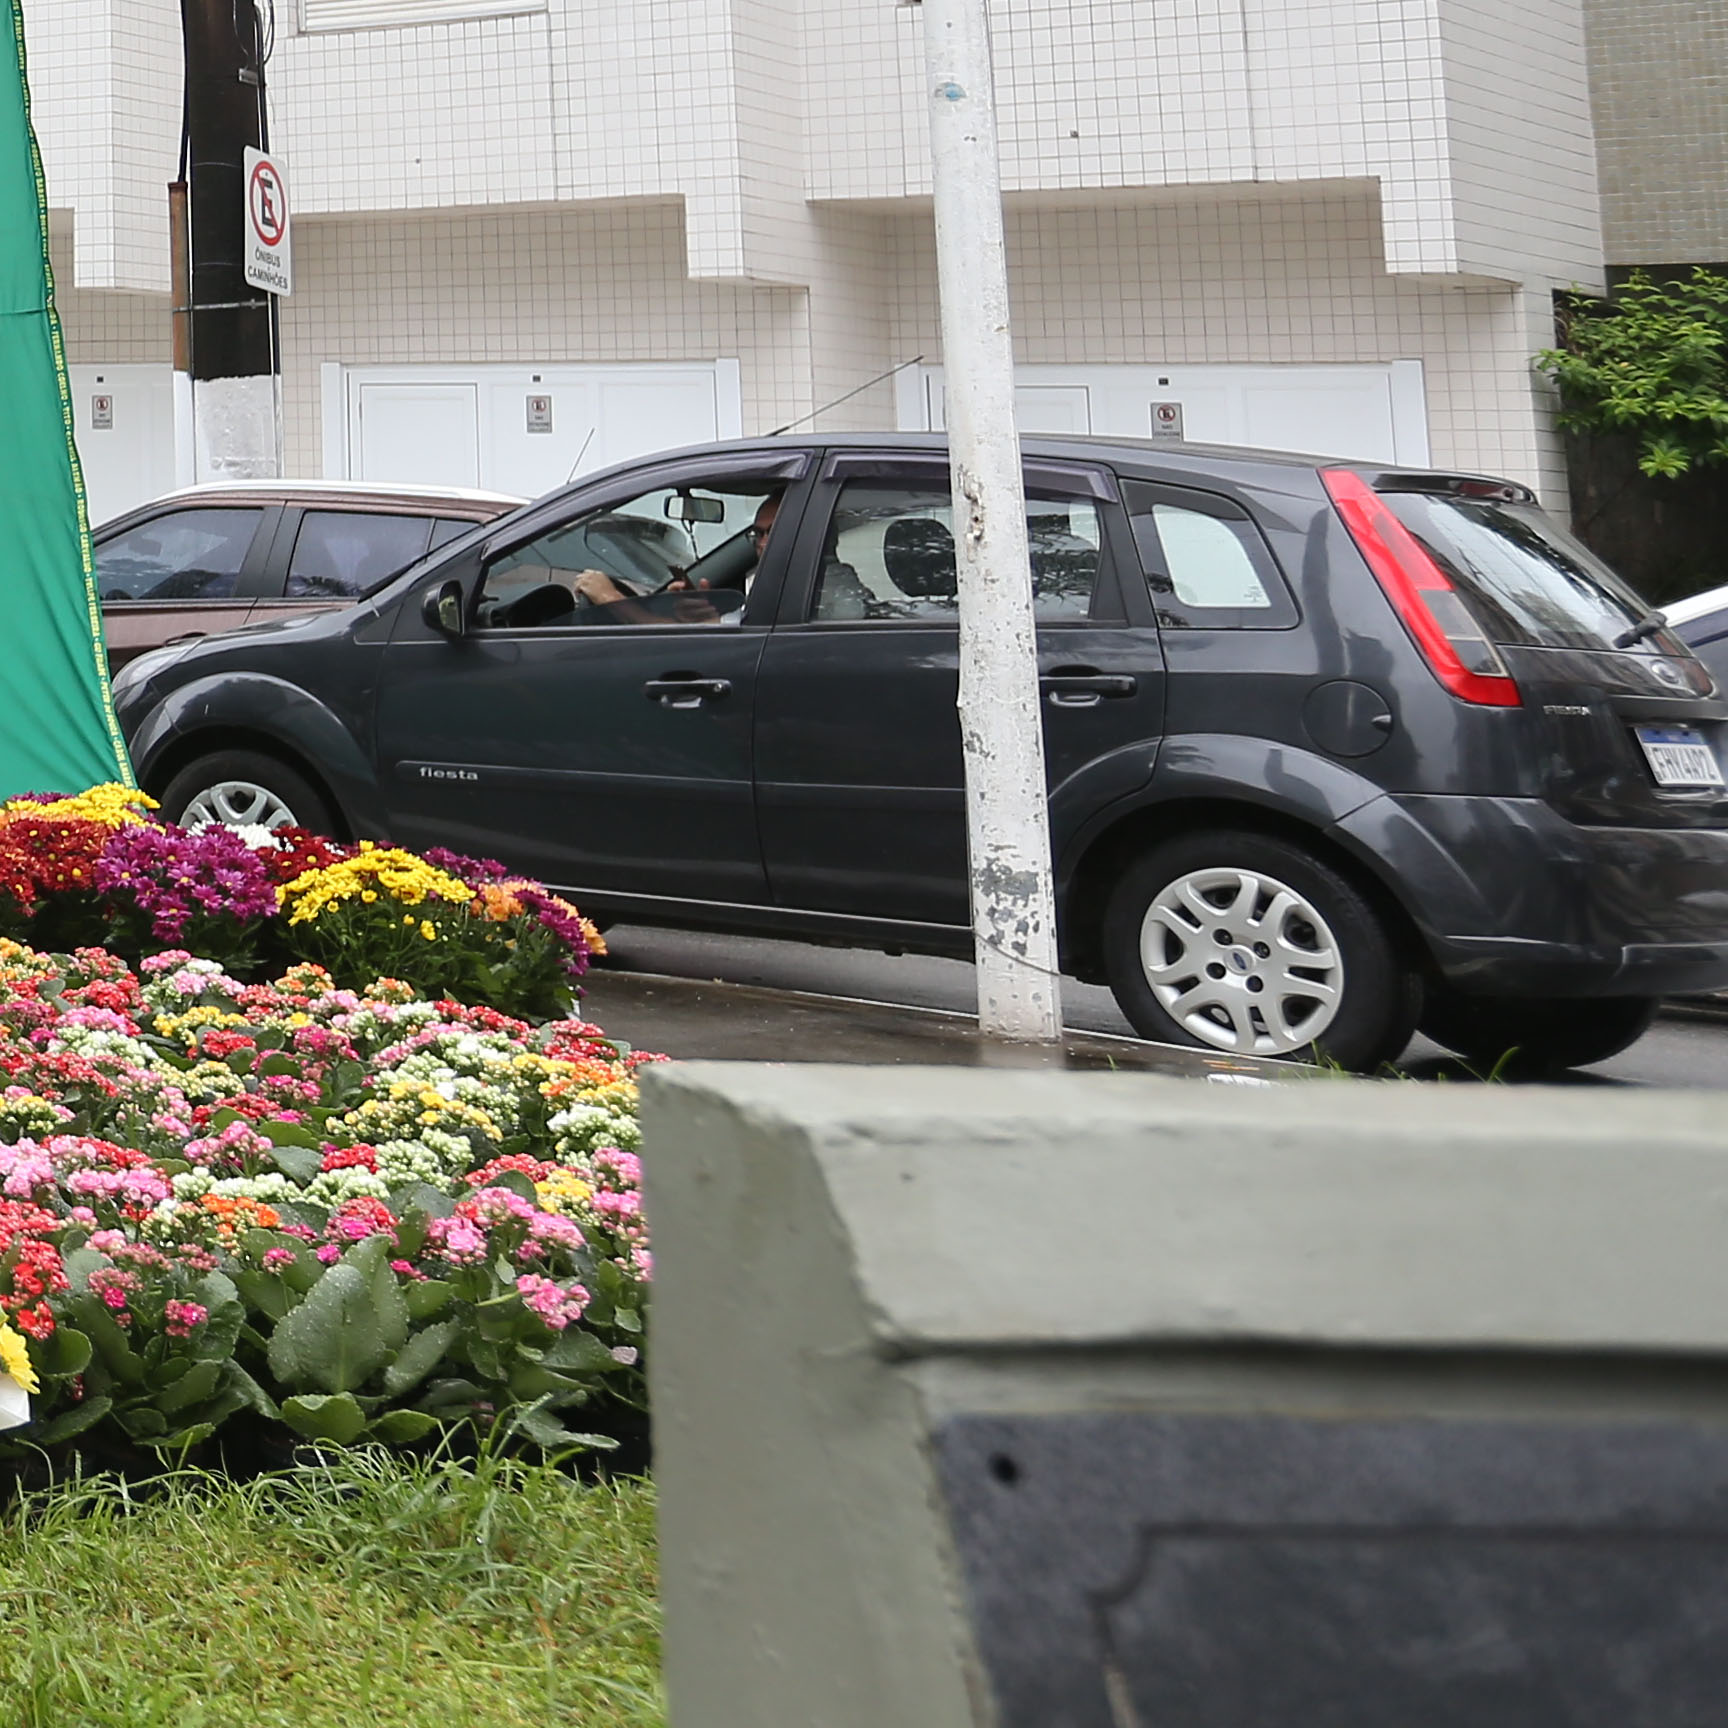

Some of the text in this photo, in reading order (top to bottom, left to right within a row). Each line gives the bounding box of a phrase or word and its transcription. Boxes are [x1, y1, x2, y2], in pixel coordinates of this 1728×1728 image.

[254, 246, 281, 268] ÔNIBUS
[247, 265, 288, 289] CAMINHÕES
[419, 766, 478, 781] fiesta
